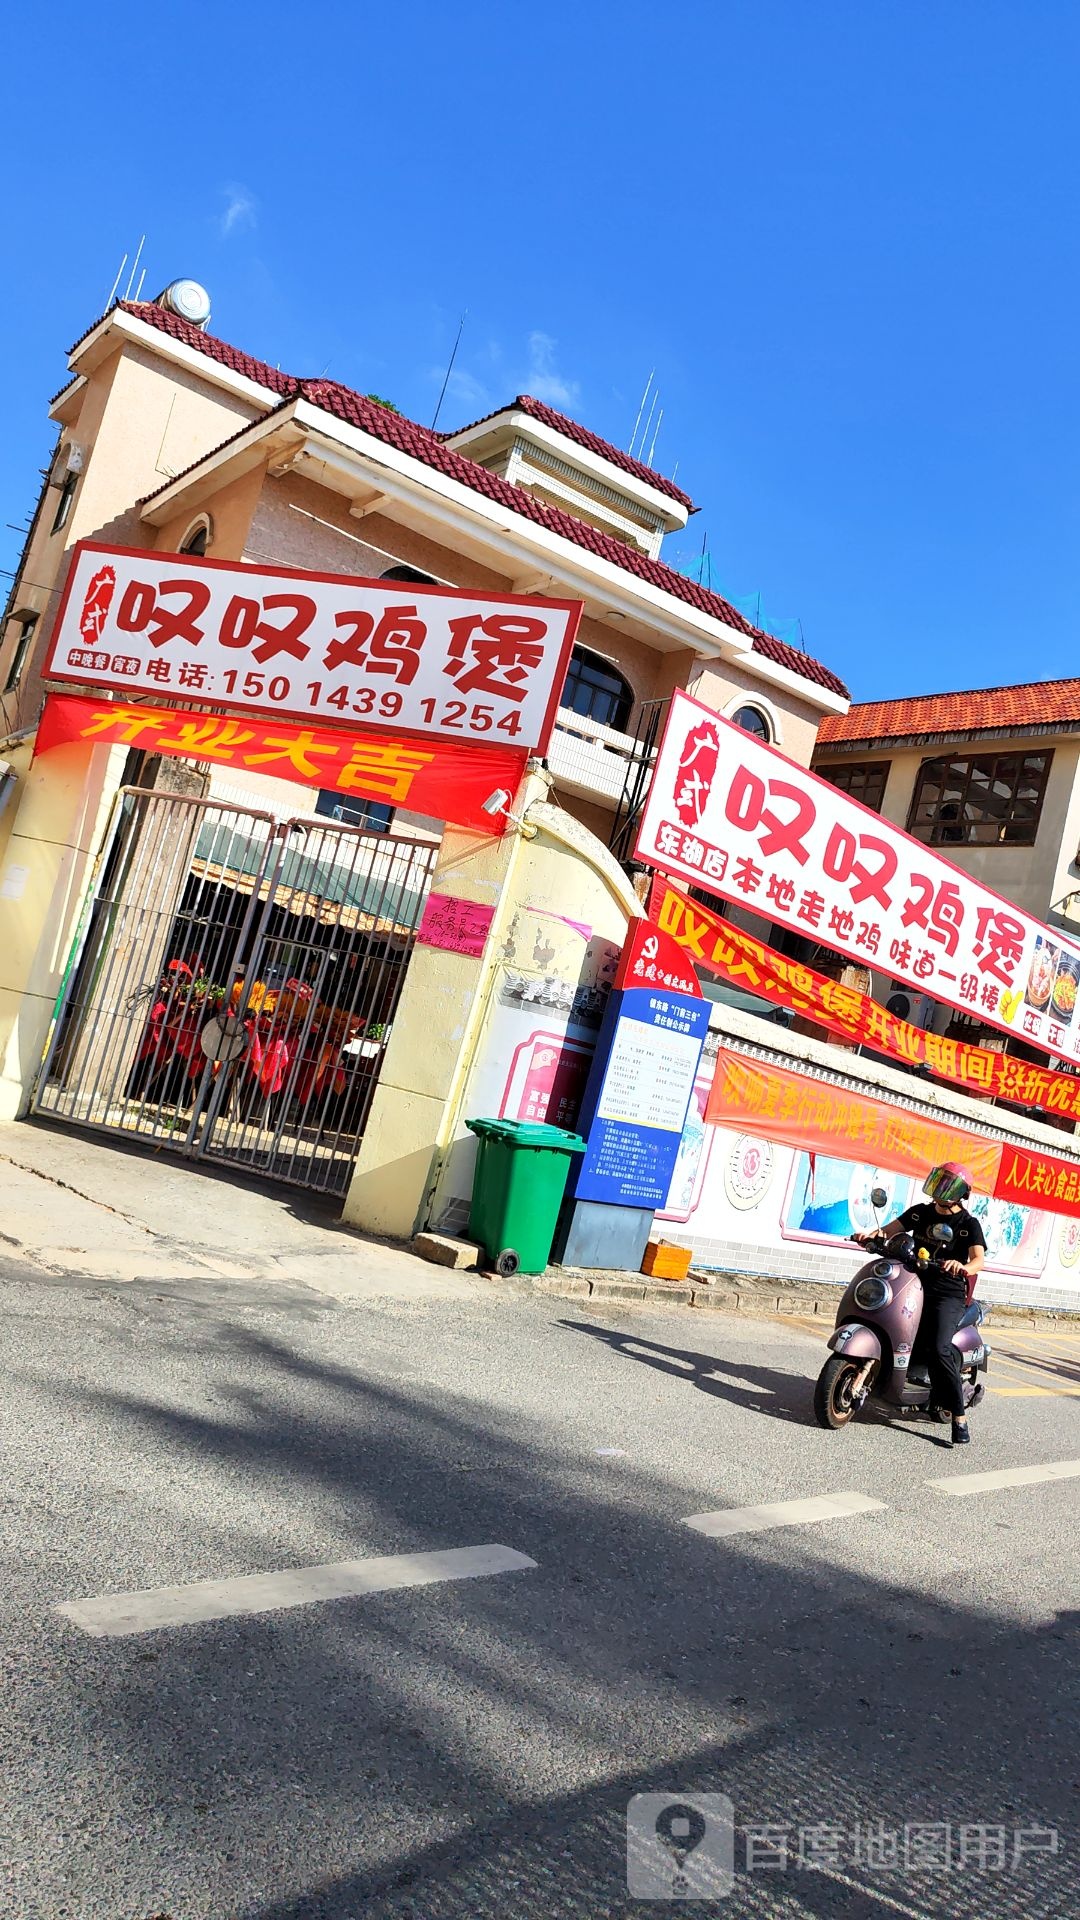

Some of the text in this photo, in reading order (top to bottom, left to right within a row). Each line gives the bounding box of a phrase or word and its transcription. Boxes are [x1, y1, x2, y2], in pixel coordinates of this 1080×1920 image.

[82, 572, 114, 636] 广式
[116, 579, 548, 702] 叹叹鸡煲
[69, 650, 108, 670] 中晚餐
[112, 657, 140, 674] 宵夜
[306, 681, 403, 717] 1439
[420, 697, 522, 736] 1254
[80, 707, 435, 802] 开业大吉
[677, 732, 718, 822] 广式
[657, 824, 999, 1012] 东湖店 本地走地鸡 味道一级棒
[725, 764, 1026, 987] 叹叹鸡煲
